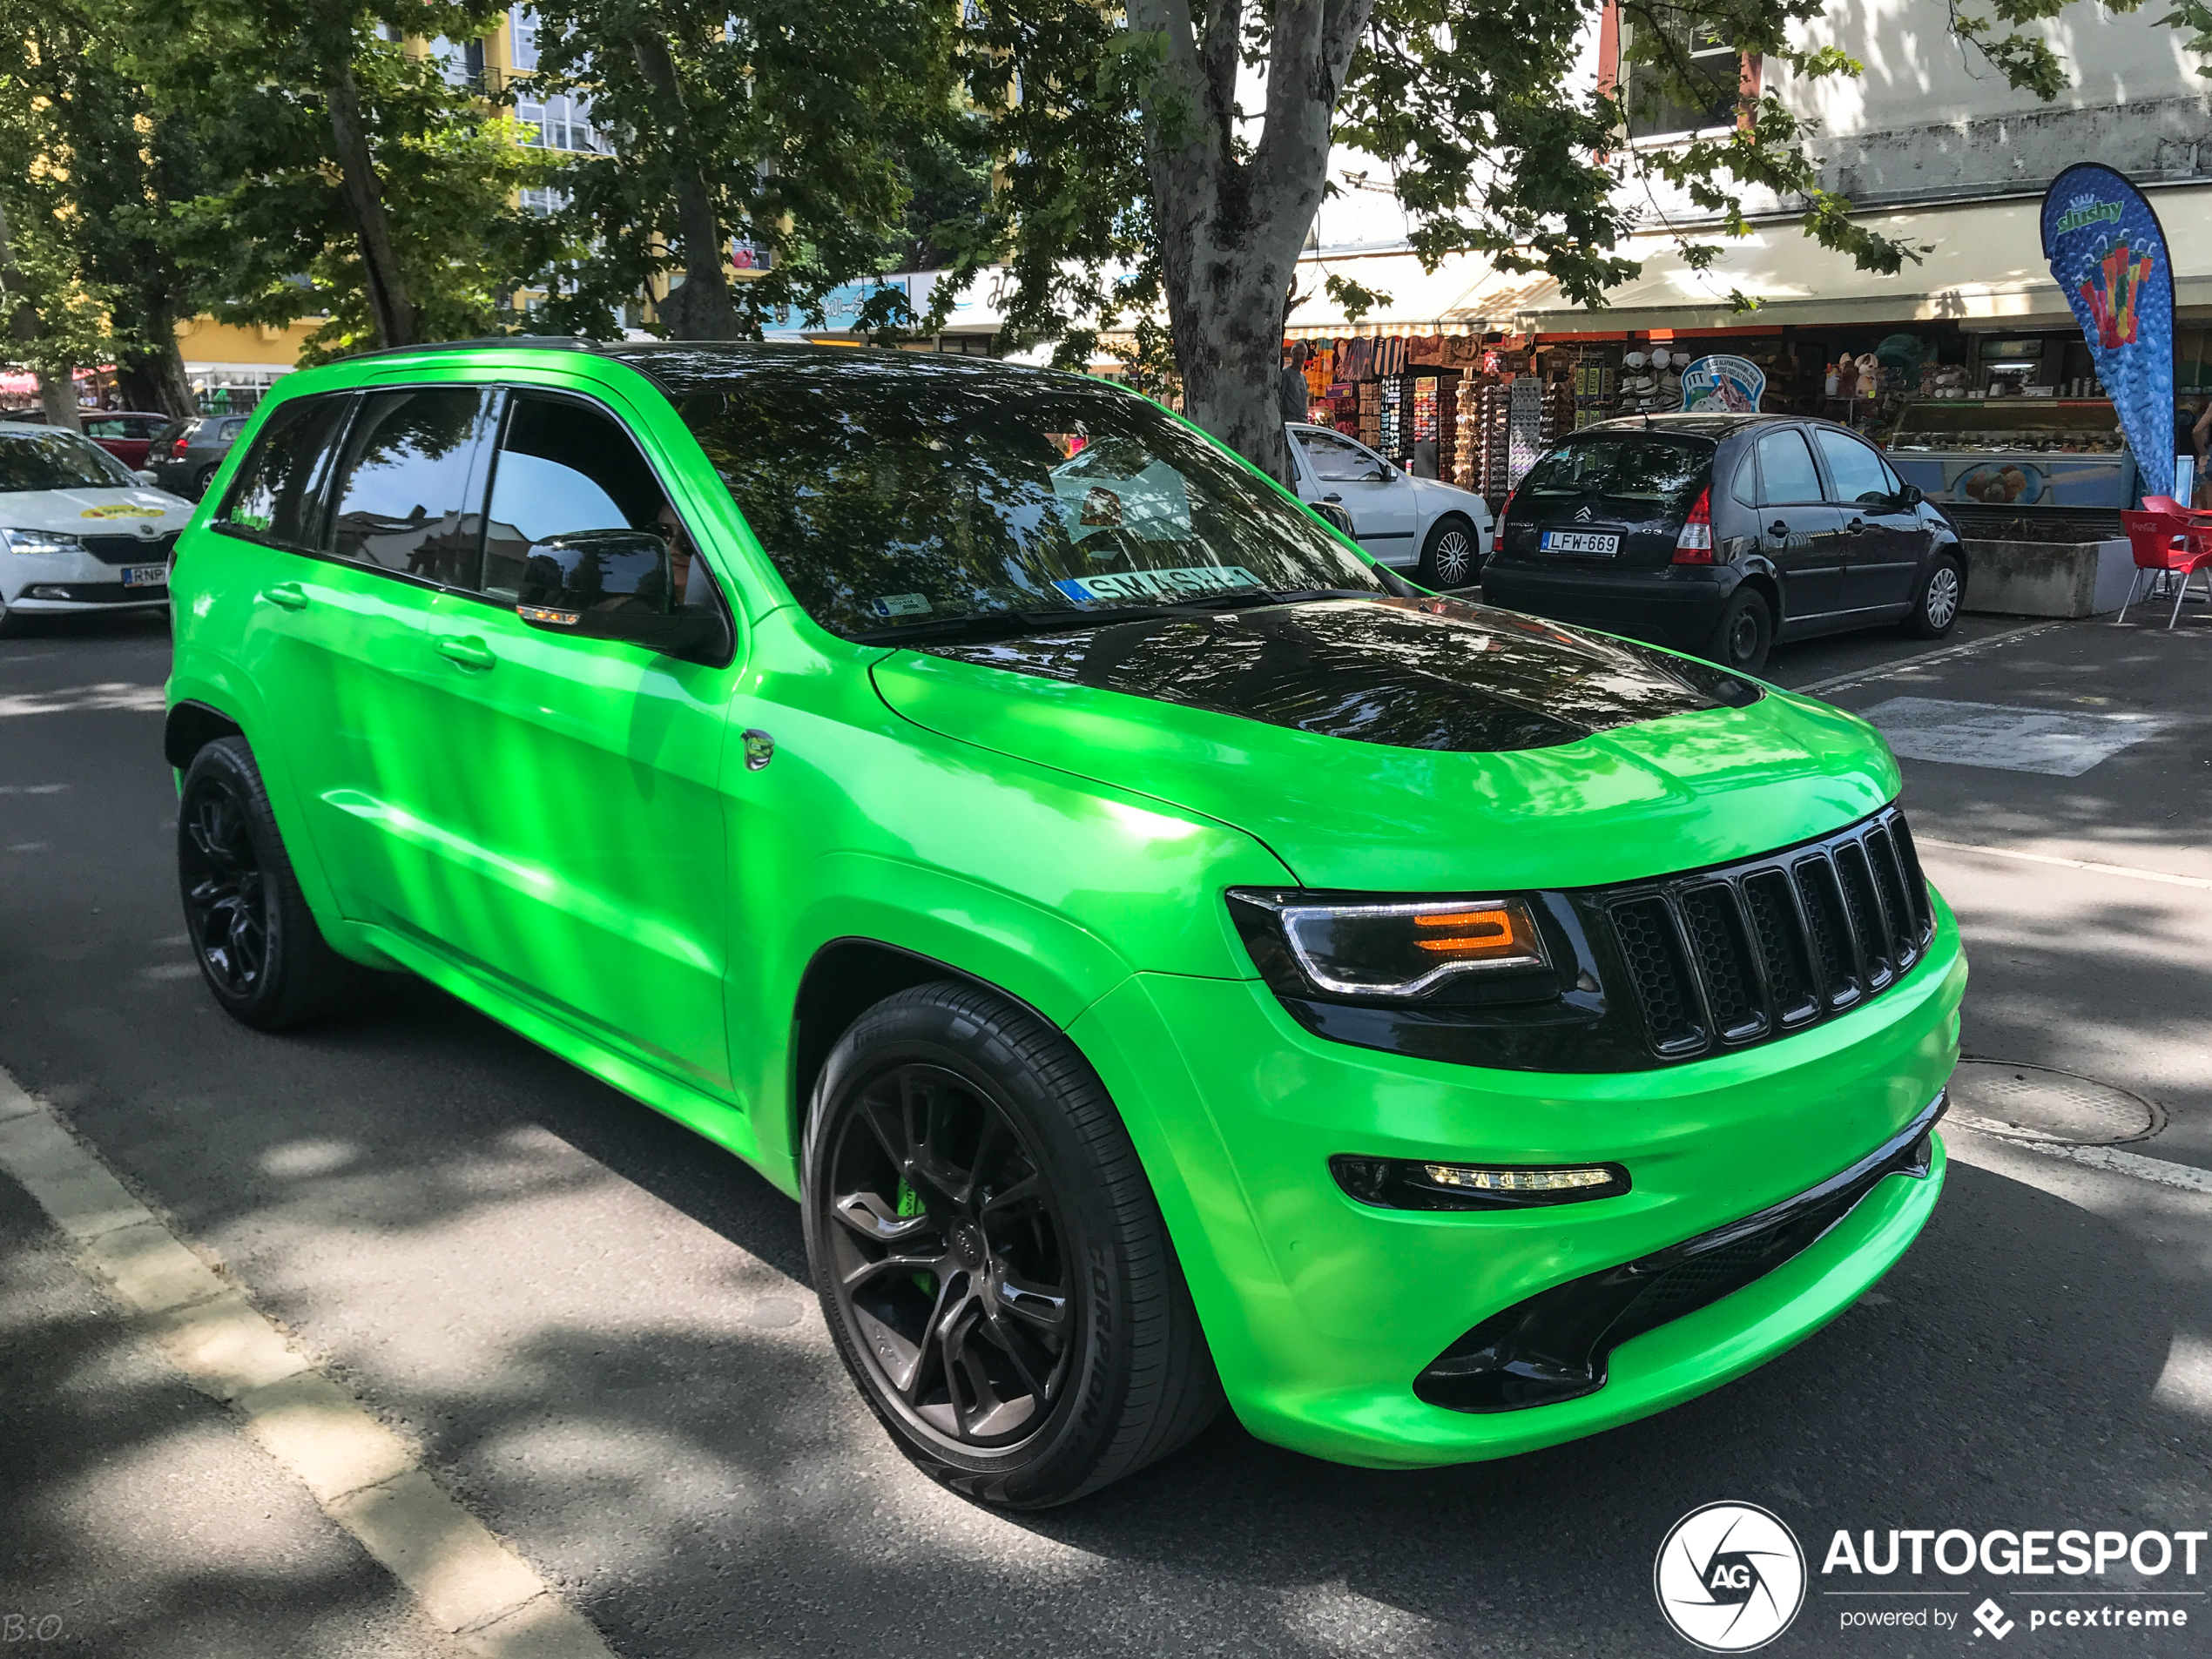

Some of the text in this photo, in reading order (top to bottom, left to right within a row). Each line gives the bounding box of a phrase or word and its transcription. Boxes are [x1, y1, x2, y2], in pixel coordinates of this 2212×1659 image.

[2057, 200, 2124, 235] slushy
[819, 297, 843, 320] AUI
[1688, 373, 1704, 387] ITT
[1551, 534, 1615, 552] LFW-669
